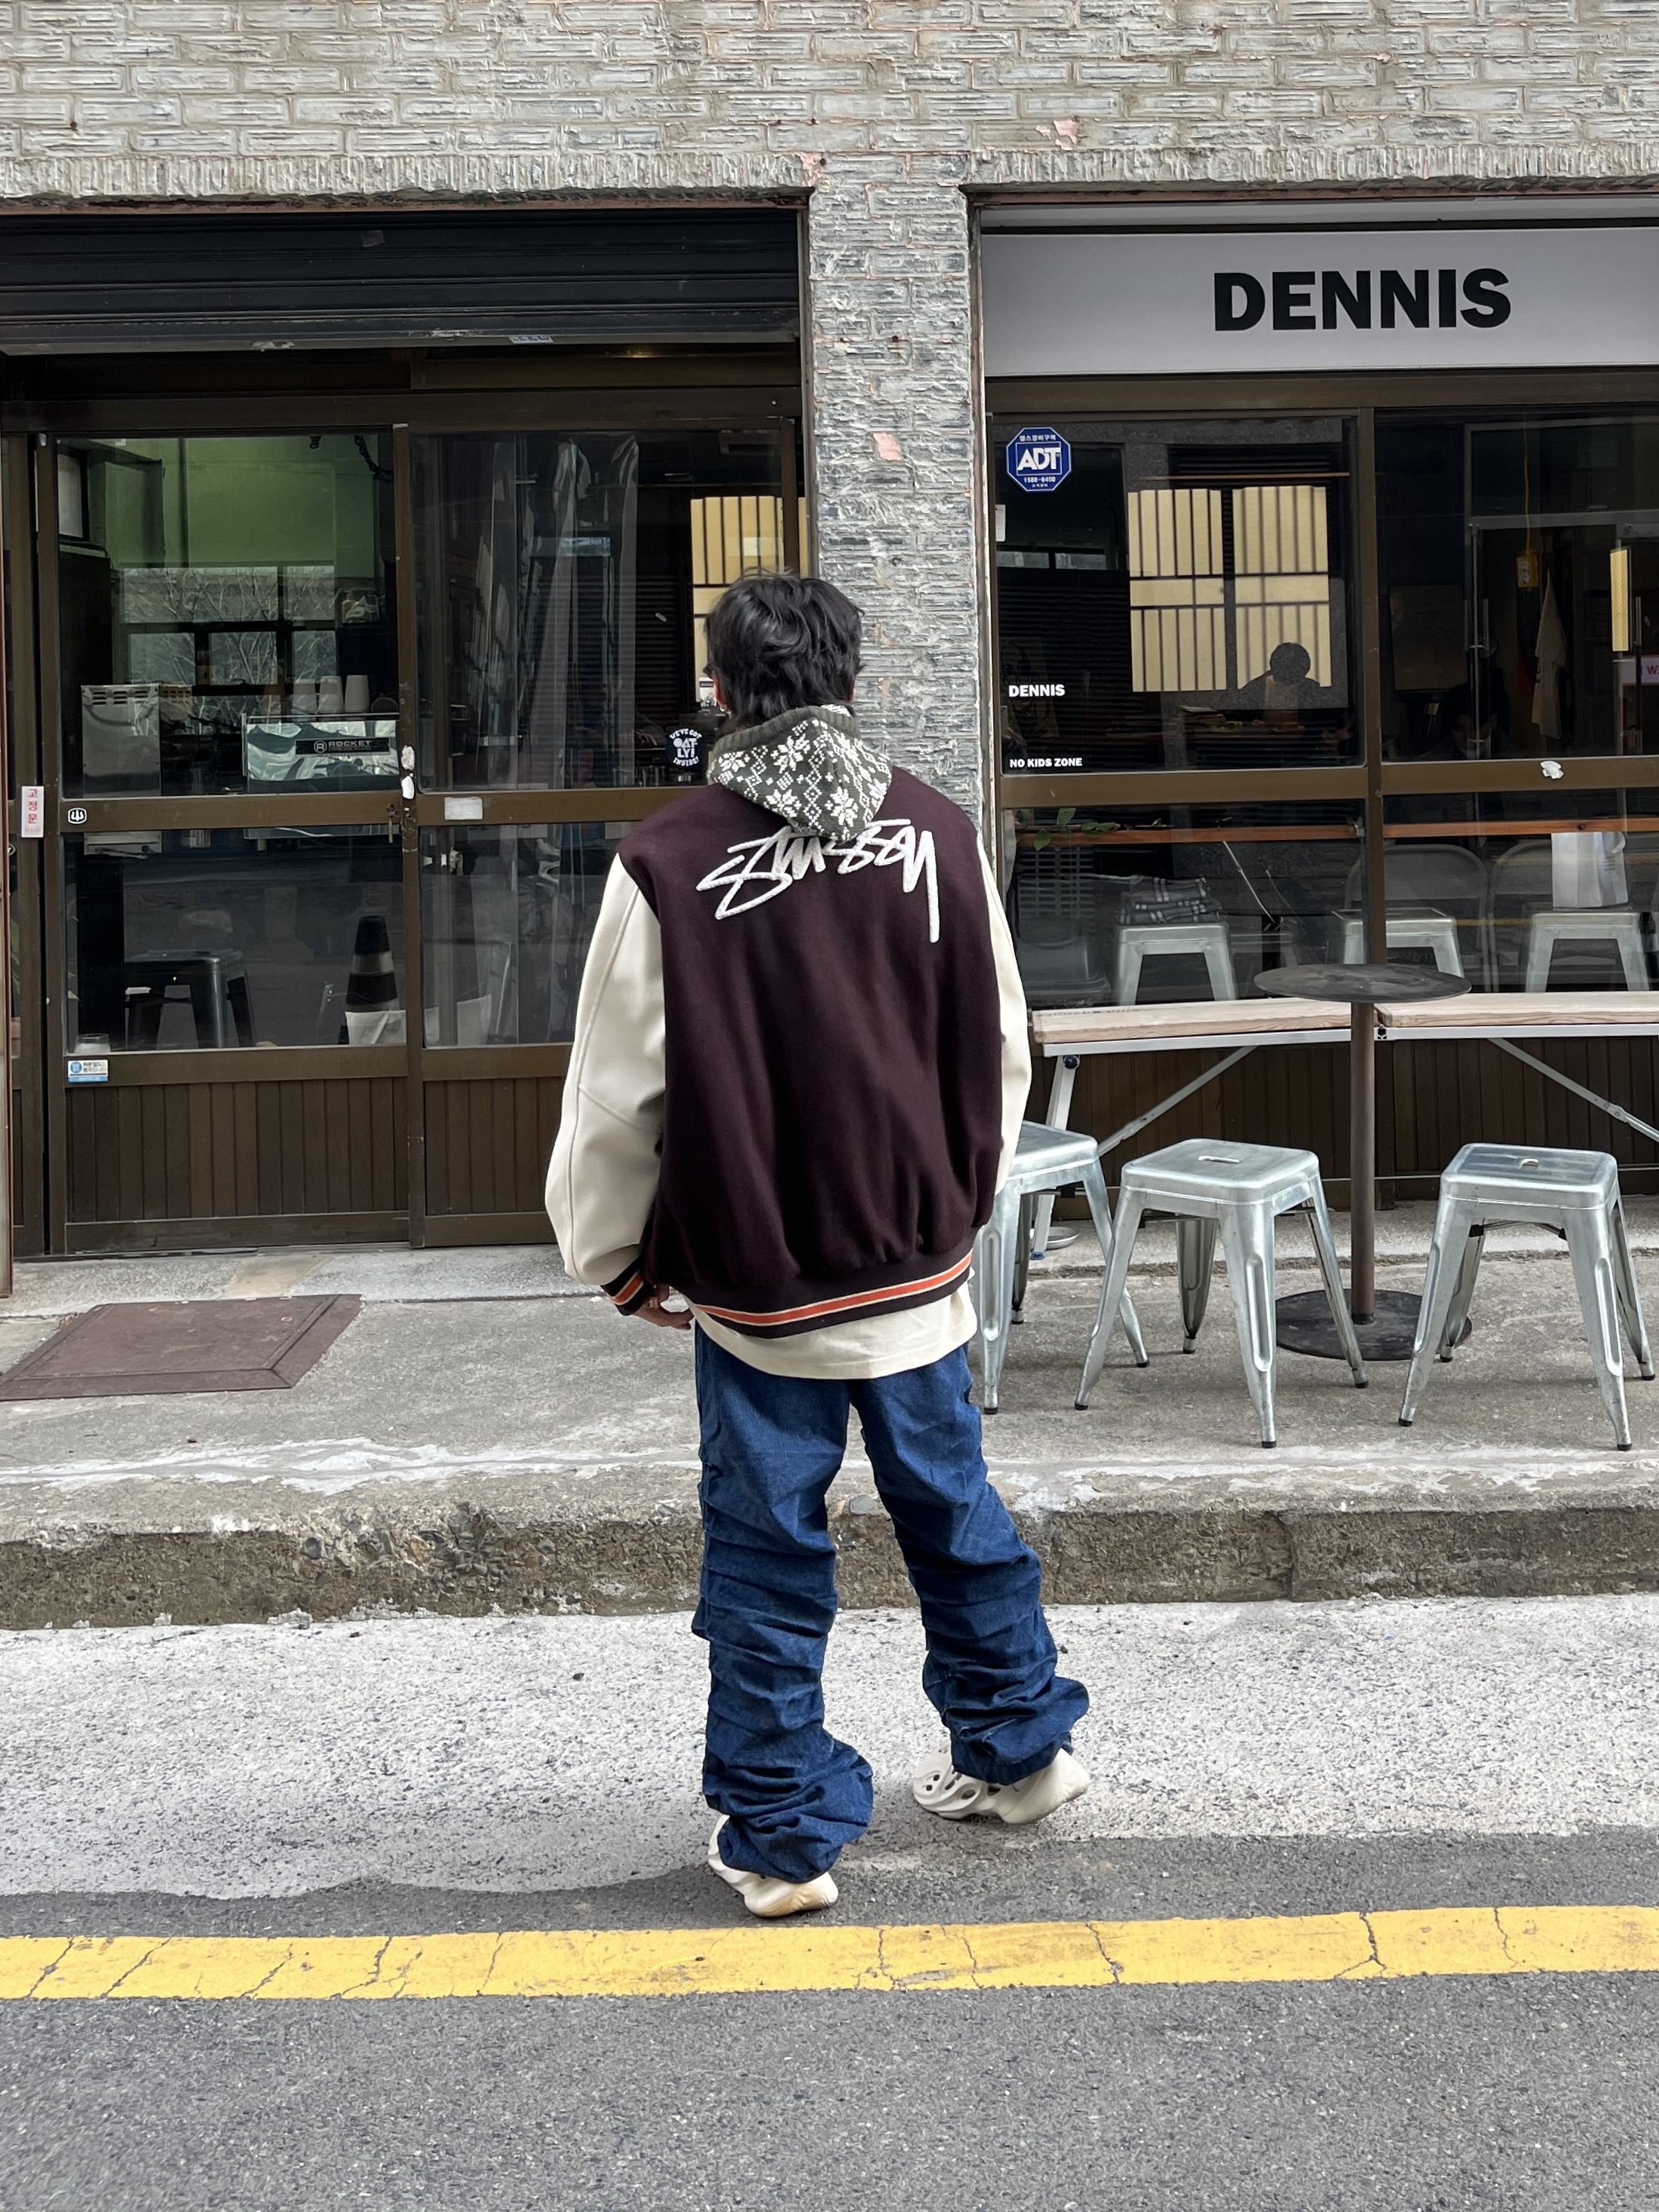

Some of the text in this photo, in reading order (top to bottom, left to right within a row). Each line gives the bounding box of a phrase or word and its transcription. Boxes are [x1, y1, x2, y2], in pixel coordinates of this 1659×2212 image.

[1213, 268, 1511, 332] DENNIS
[1017, 446, 1061, 470] ADT
[1008, 684, 1066, 697] DENNIS
[1010, 757, 1083, 767] NO KIDS ZONE
[27, 788, 38, 824] 고정문
